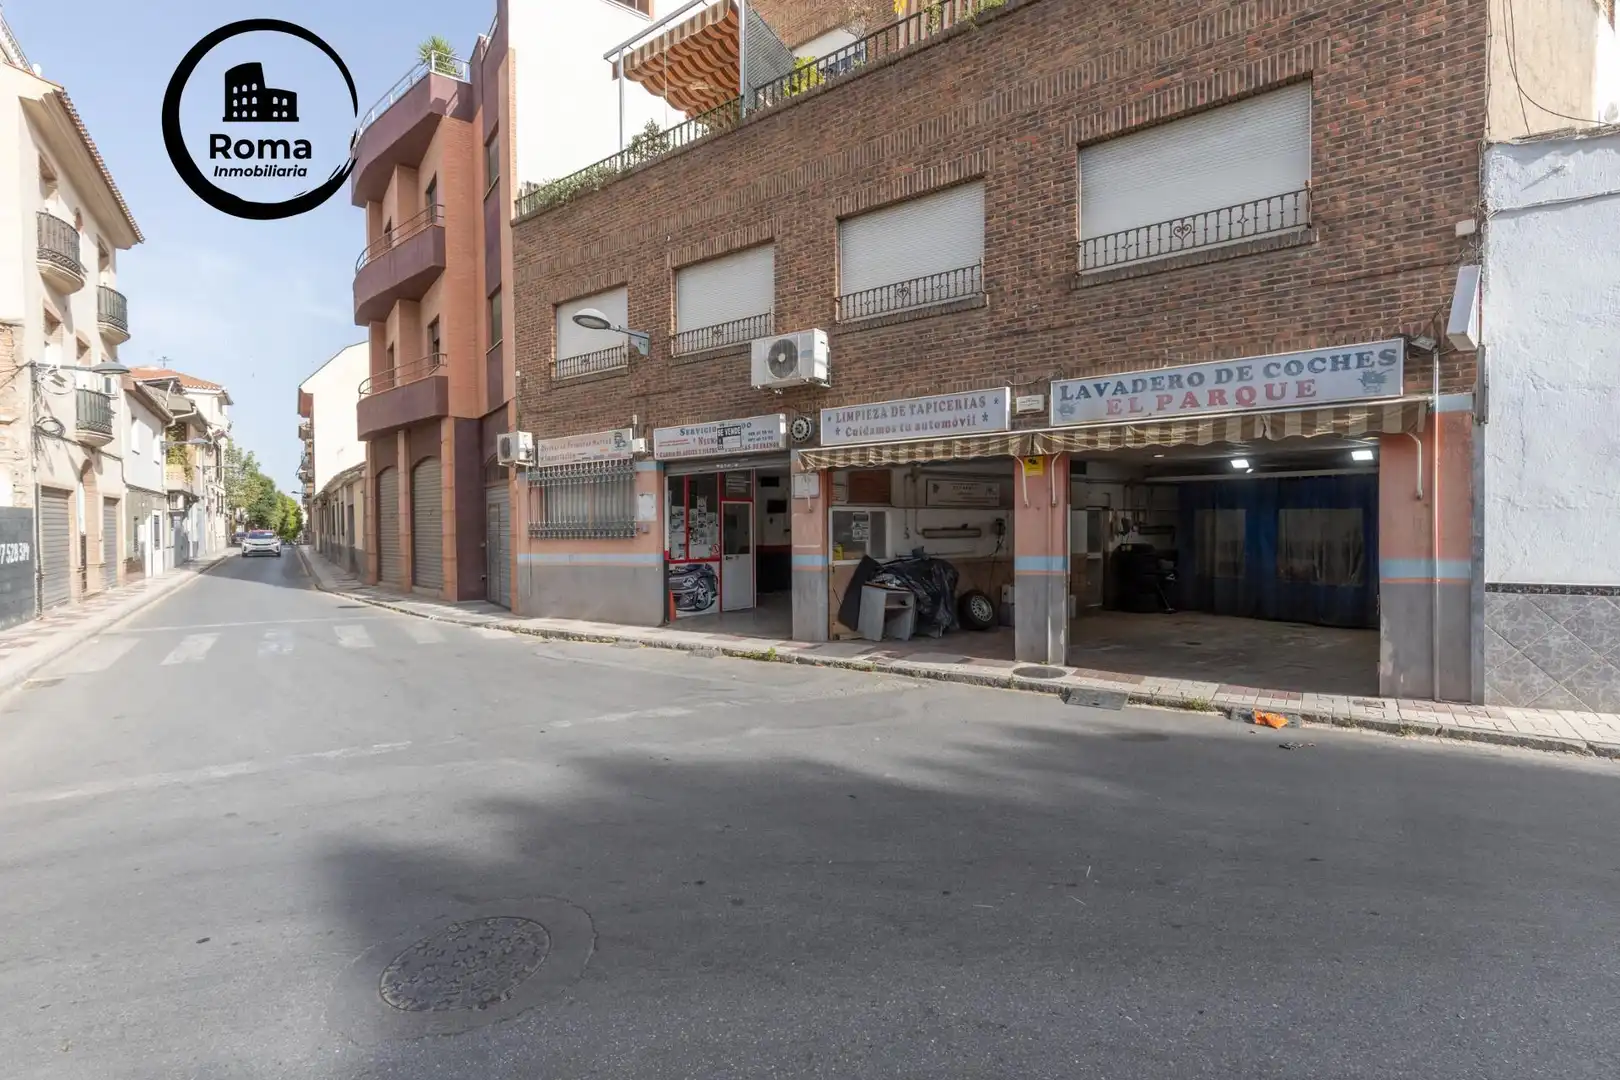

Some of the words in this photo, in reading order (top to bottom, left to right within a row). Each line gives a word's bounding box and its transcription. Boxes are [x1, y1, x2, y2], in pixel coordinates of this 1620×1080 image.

[1059, 371, 1206, 402] LAVADERO
[1214, 365, 1254, 385] DE
[1262, 348, 1398, 379] COCHES
[1105, 397, 1144, 416] EL
[1155, 378, 1318, 411] PARQUE
[835, 406, 888, 424] LIMPIEZA
[891, 404, 906, 418] DE
[717, 429, 725, 437] SE
[725, 426, 741, 436] VENDE
[845, 425, 897, 438] Cuidamos
[900, 423, 912, 433] tu
